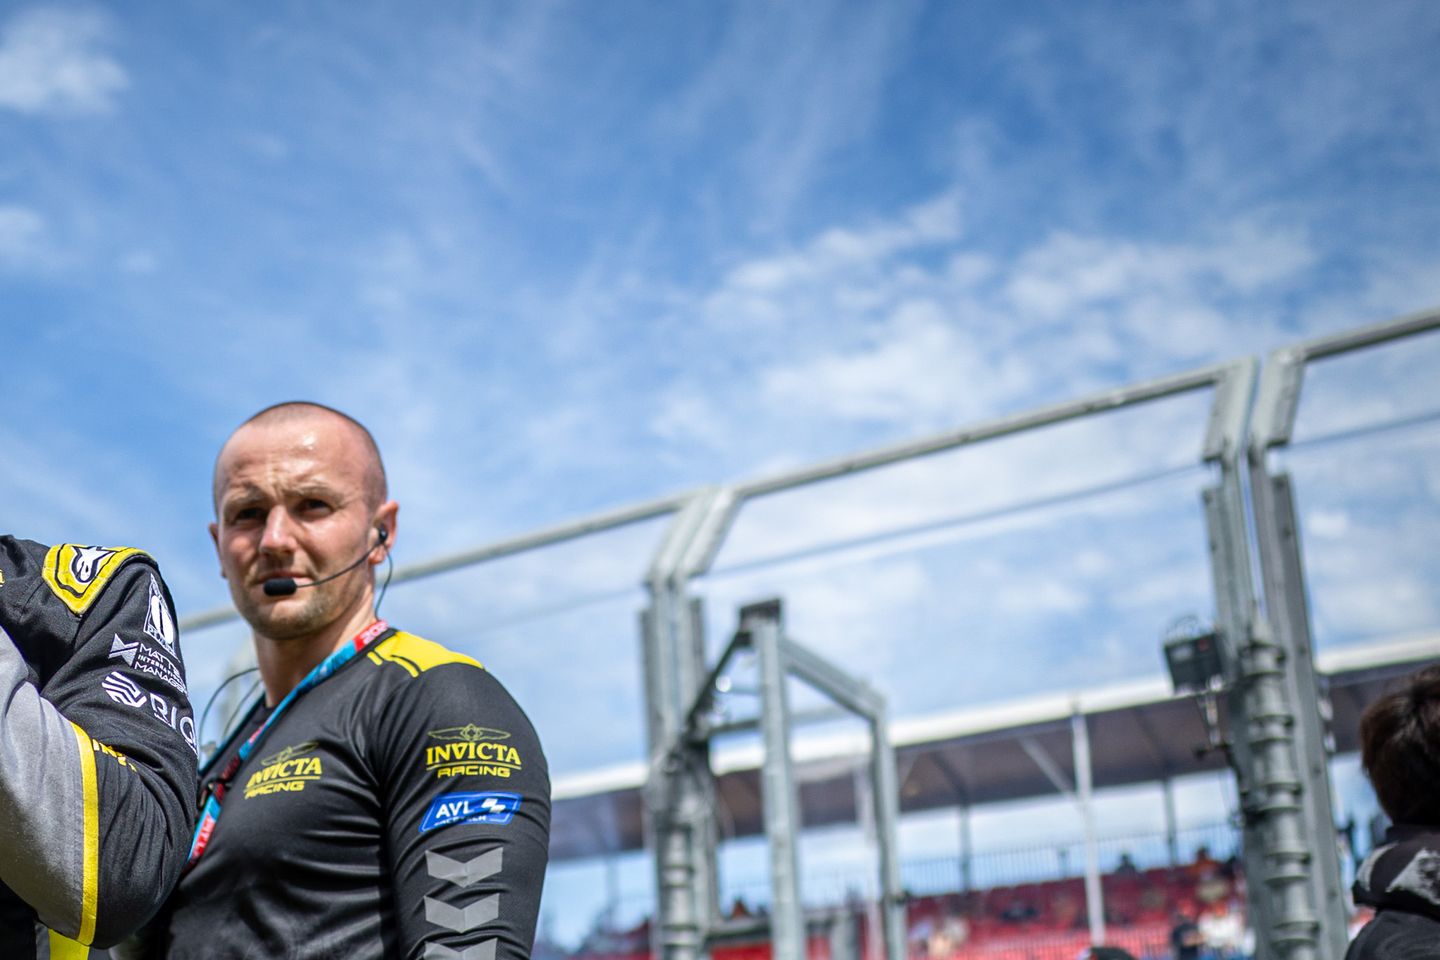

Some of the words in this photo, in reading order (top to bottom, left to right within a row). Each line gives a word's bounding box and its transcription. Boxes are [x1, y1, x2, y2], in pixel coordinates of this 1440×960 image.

[426, 742, 522, 766] INVICTA
[246, 757, 322, 789] INVICTA
[437, 765, 511, 779] RACING
[244, 780, 305, 800] RACING
[435, 800, 475, 819] AVL
